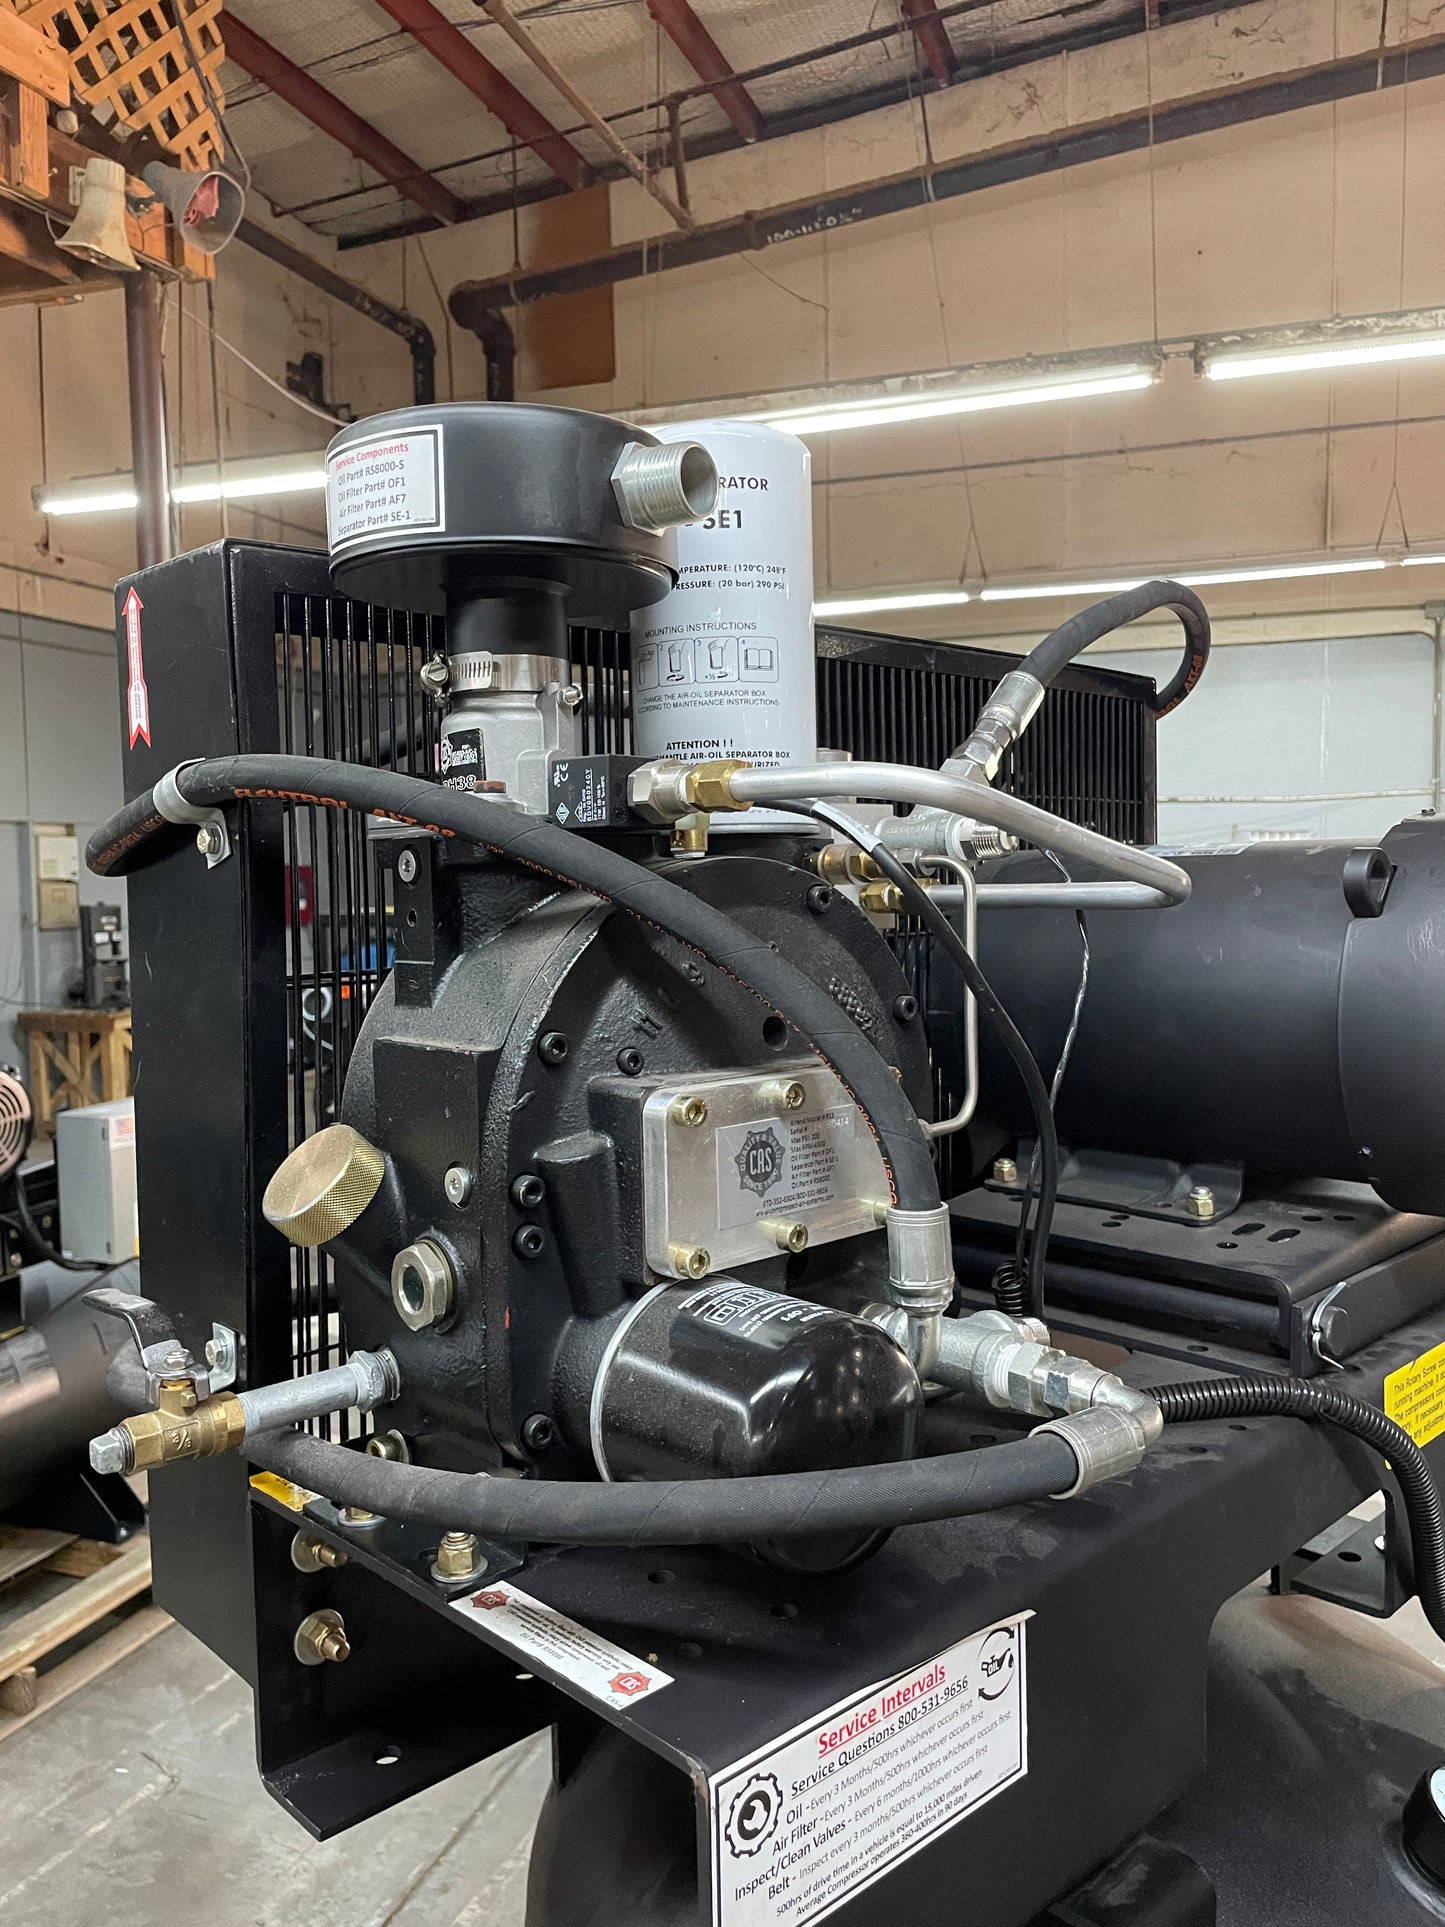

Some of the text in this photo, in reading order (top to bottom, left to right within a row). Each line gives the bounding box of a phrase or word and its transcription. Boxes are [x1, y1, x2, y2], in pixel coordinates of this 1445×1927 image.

[336, 443, 409, 470] Service Components
[346, 468, 363, 482] Part#
[365, 459, 405, 476] RS8000-S
[347, 487, 362, 499] Filter
[365, 480, 385, 494] Part#
[388, 476, 406, 488] OF1
[348, 502, 364, 515] Filter
[366, 496, 386, 510] Part#
[389, 494, 406, 505] AF7
[338, 519, 365, 536] Separator
[367, 513, 388, 526] Part#
[391, 510, 411, 522] SE-1
[718, 580, 732, 589] (20
[736, 579, 754, 589] bar)
[774, 581, 785, 590] PSI
[645, 622, 757, 638] MOUNTING INSTRUCTIONS
[664, 694, 675, 702] THE
[678, 691, 702, 699] AIR-OIL
[704, 690, 749, 698] SEPARATOR
[673, 699, 724, 708] MAINTENANCE
[666, 740, 719, 751] ATTENTION
[690, 751, 723, 760] AIR-OIL
[726, 750, 773, 759] SEPARATOR
[750, 1147, 772, 1175] CAS
[744, 1175, 763, 1190] SINCE
[988, 1661, 1000, 1676] OIL
[619, 1676, 642, 1690] CAS
[818, 1664, 946, 1756] Service Intervals
[792, 1675, 969, 1797] Service Questions 800-531-9656
[787, 1803, 802, 1825] Oil
[841, 1745, 900, 1791] Months/500hrs
[900, 1722, 936, 1752] whichever
[937, 1709, 959, 1728] occurs
[960, 1700, 973, 1716] first
[773, 1836, 788, 1856] Air
[791, 1817, 818, 1844] Filter
[854, 1758, 911, 1803] Months/500hrs
[912, 1735, 947, 1763] whichever
[949, 1720, 970, 1739] occurs
[971, 1711, 984, 1726] first
[735, 1843, 811, 1901] Inspect/Clean
[813, 1820, 846, 1848] Valves
[855, 1802, 875, 1822] Every
[883, 1757, 941, 1803] months/1000hrs
[942, 1732, 979, 1761] whichever
[978, 1719, 998, 1739] occurs
[999, 1711, 1011, 1725] first
[769, 1876, 791, 1900] Belt
[799, 1855, 829, 1878] Inspect
[831, 1839, 851, 1859] every
[860, 1794, 916, 1838] months/500hrs
[917, 1770, 952, 1799] whichever
[954, 1754, 974, 1773] occurs
[975, 1745, 988, 1761] first
[776, 1895, 801, 1917] 500hrs
[804, 1885, 812, 1898] of
[813, 1874, 832, 1892] drive
[833, 1861, 849, 1877] time
[850, 1855, 857, 1866] in
[864, 1833, 889, 1857] vehicle
[896, 1815, 915, 1837] equal
[916, 1809, 923, 1820] to
[924, 1793, 946, 1815] 15,000
[946, 1782, 962, 1799] miles
[964, 1769, 983, 1787] driven
[796, 1891, 826, 1917] Average
[828, 1861, 869, 1894] Compressor
[871, 1841, 901, 1864] operates
[937, 1807, 944, 1818] in
[945, 1802, 953, 1813] 90
[954, 1792, 968, 1806] days
